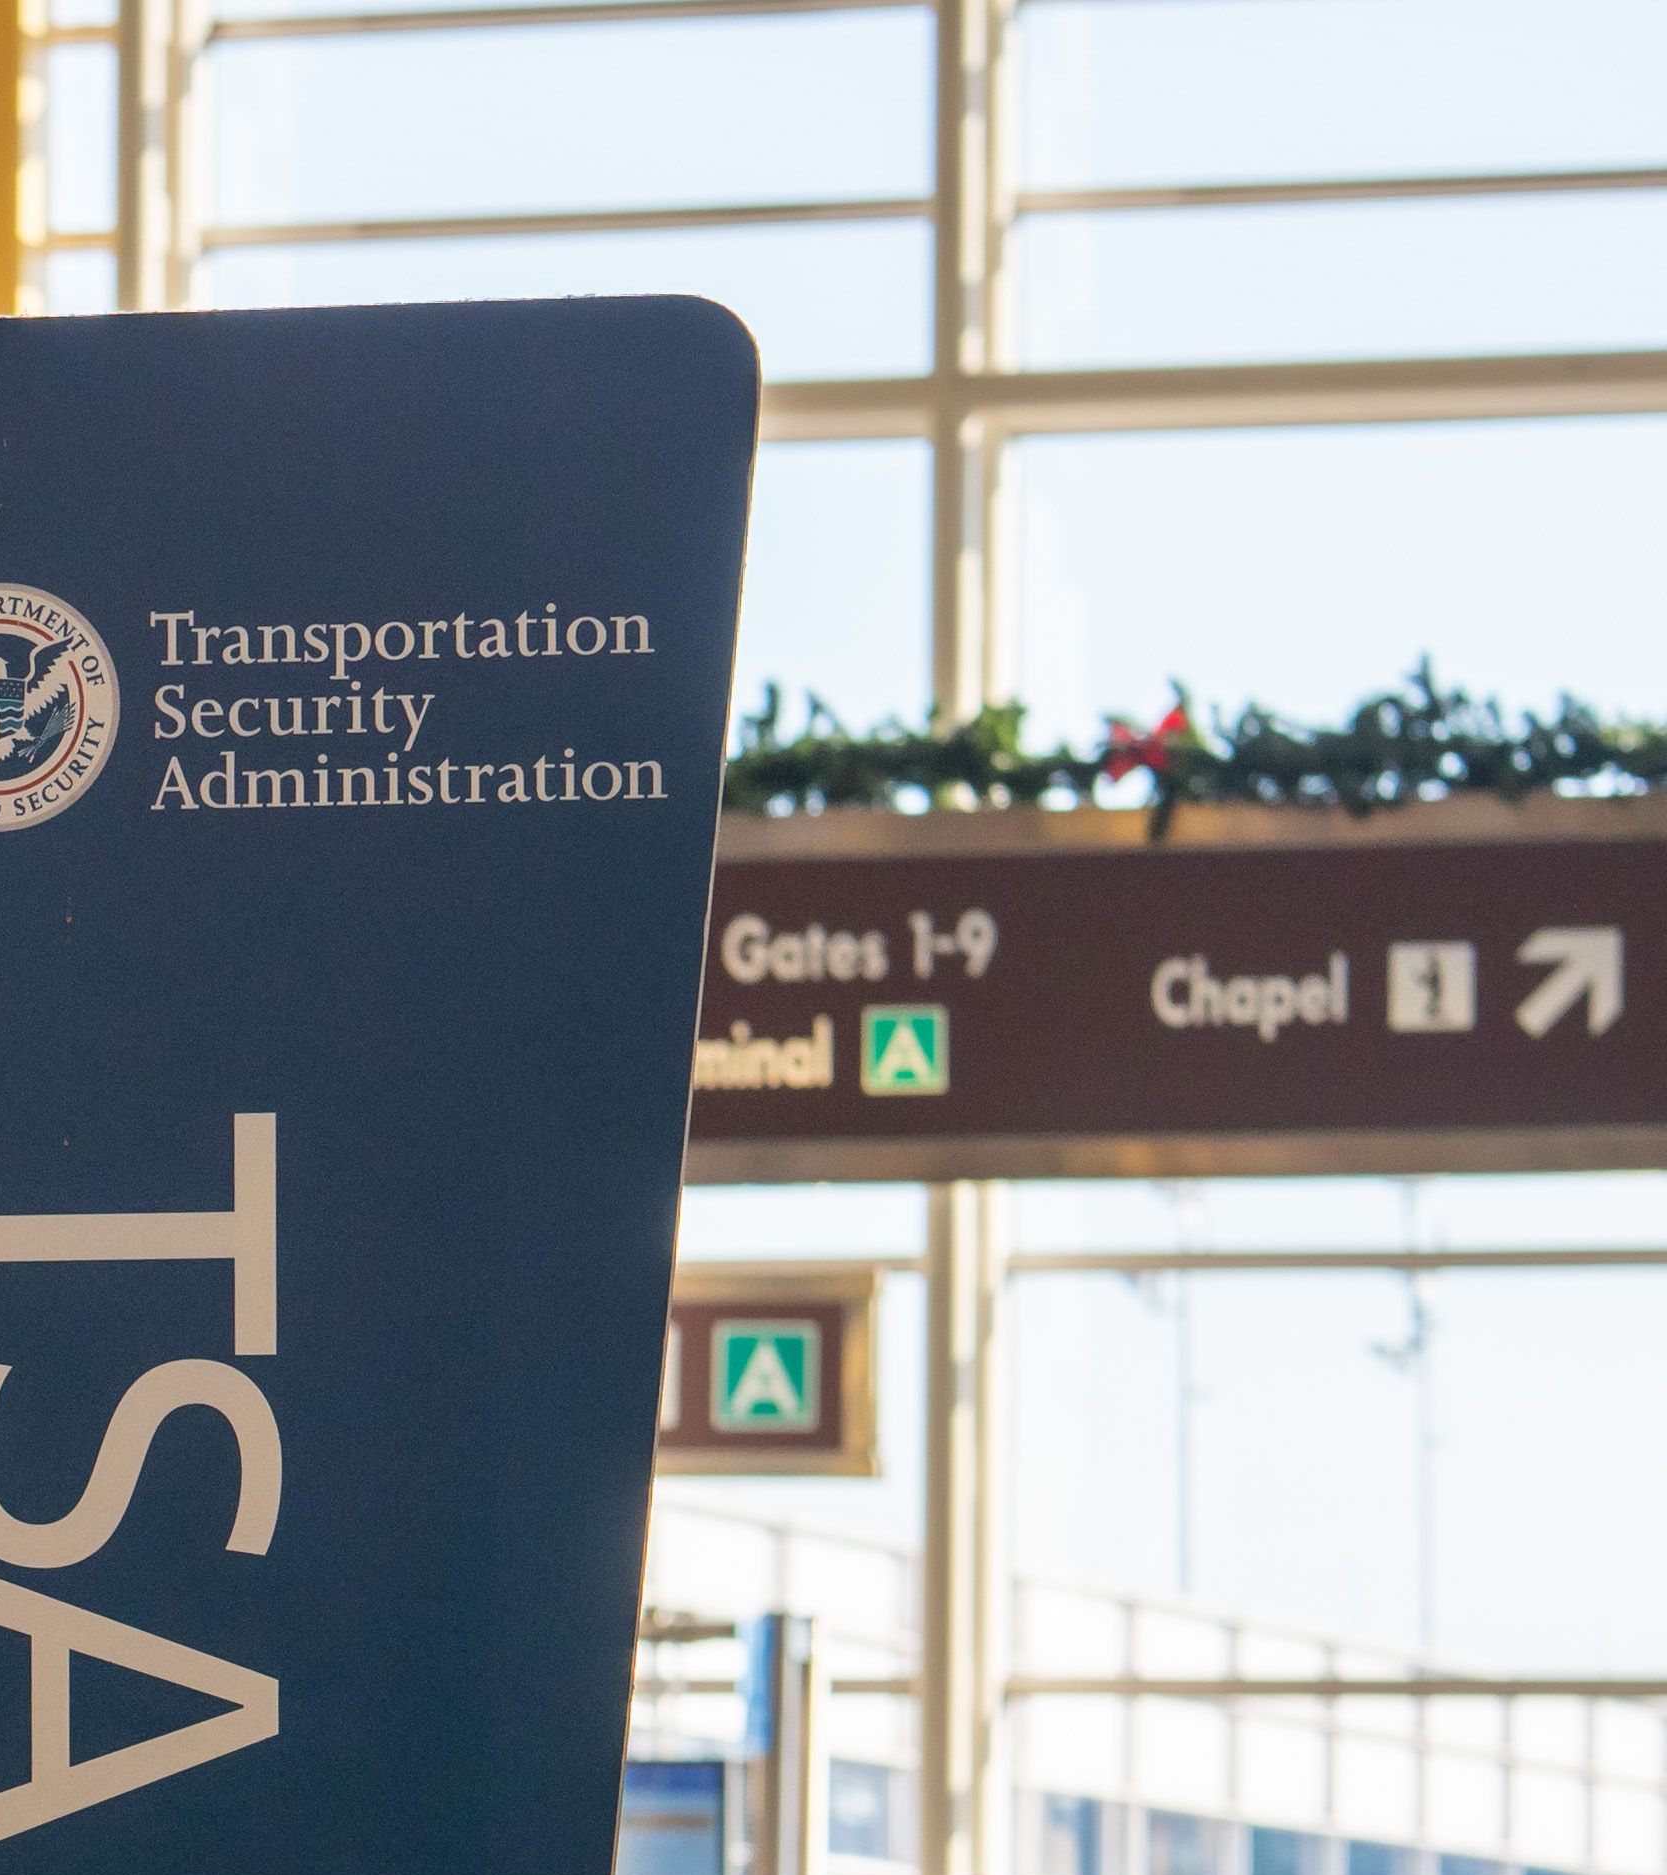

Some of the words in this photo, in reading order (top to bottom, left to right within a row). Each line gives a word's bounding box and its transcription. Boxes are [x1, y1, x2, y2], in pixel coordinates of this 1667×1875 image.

[80, 654, 107, 688] OF
[151, 603, 656, 680] Transportation
[154, 680, 436, 752] Security
[12, 716, 106, 818] SECURITY
[151, 747, 669, 810] Administration
[721, 912, 889, 985] Gates
[908, 906, 999, 980] 1-9
[1149, 948, 1352, 1043] Chapel
[692, 1012, 835, 1090] minal
[870, 1011, 940, 1091] A
[724, 1331, 807, 1425] A
